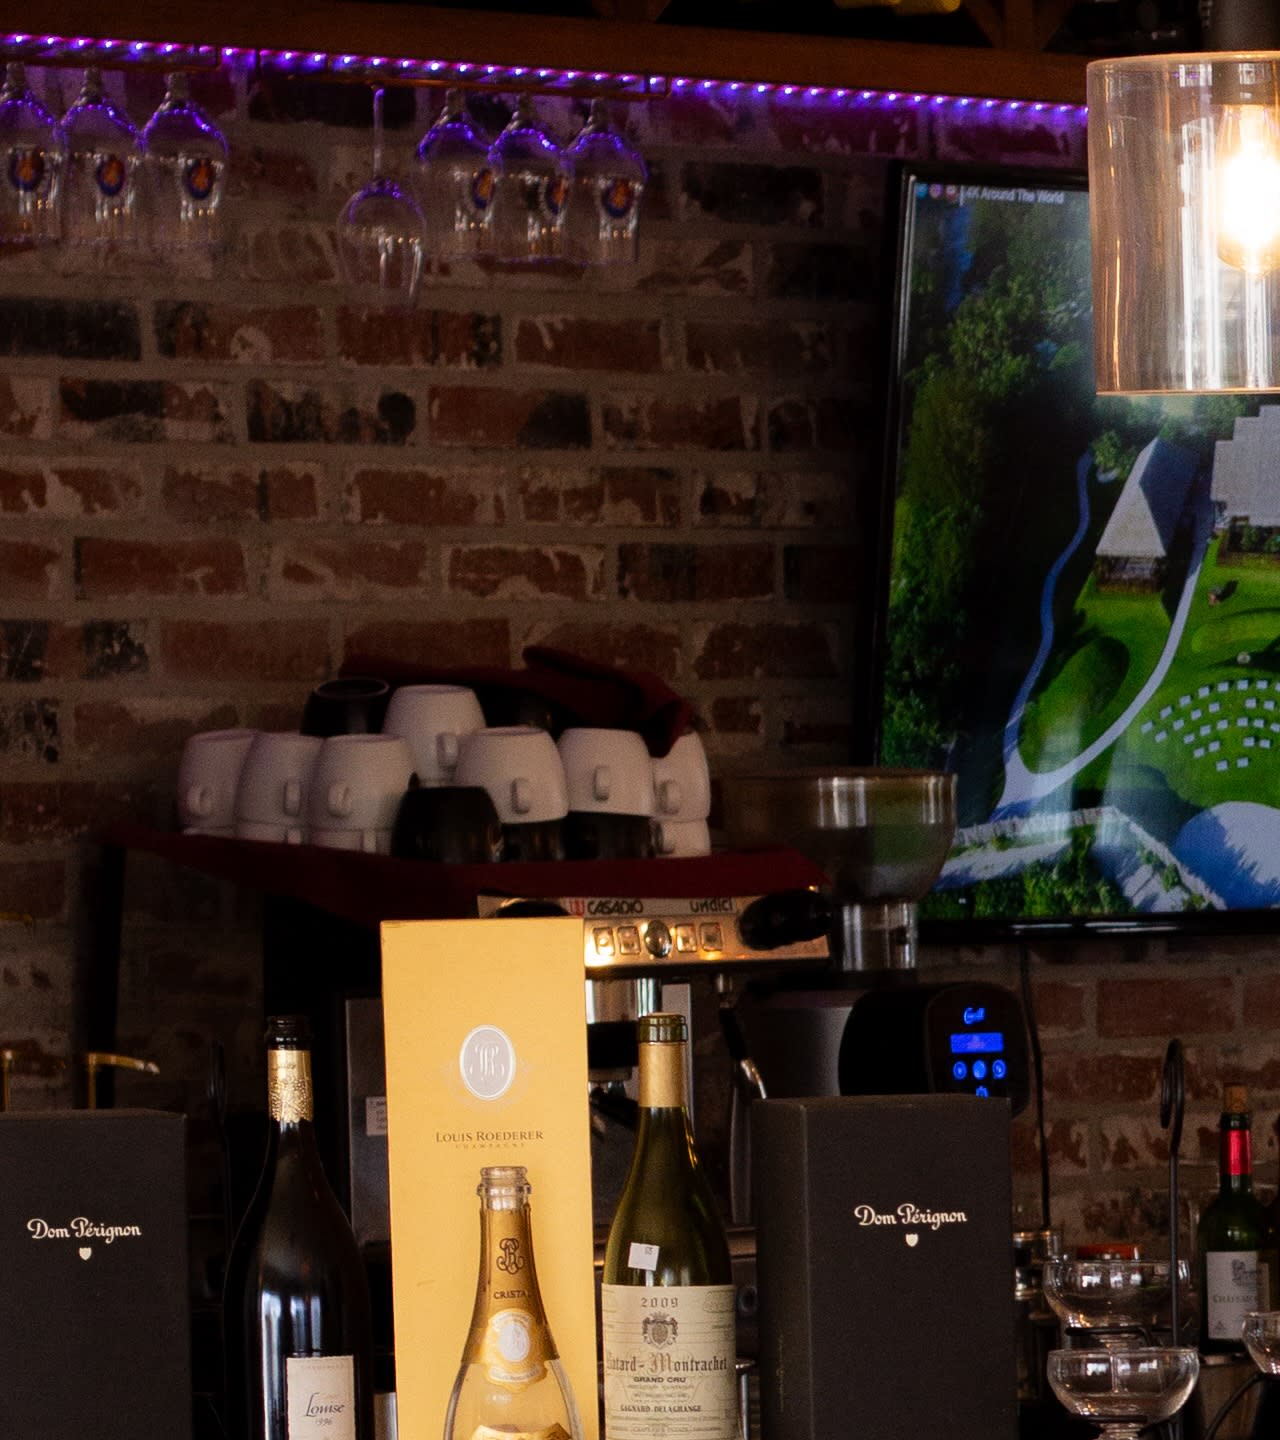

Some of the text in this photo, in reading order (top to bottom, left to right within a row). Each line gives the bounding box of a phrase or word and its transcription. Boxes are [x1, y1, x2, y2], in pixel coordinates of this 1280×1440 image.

[981, 186, 1015, 201] Around
[1017, 187, 1036, 202] The
[1038, 190, 1064, 205] World
[587, 899, 643, 915] CASADIO
[435, 1130, 544, 1143] LOUIS ROEDERER
[853, 1202, 968, 1231] Dom Pérignon
[26, 1216, 142, 1244] Dom Pérignon
[493, 1290, 533, 1300] CRISTAL
[640, 1296, 679, 1309] 2009
[649, 1351, 728, 1374] Montrachet
[633, 1376, 687, 1384] GRAND CRU
[303, 1392, 345, 1418] Louise
